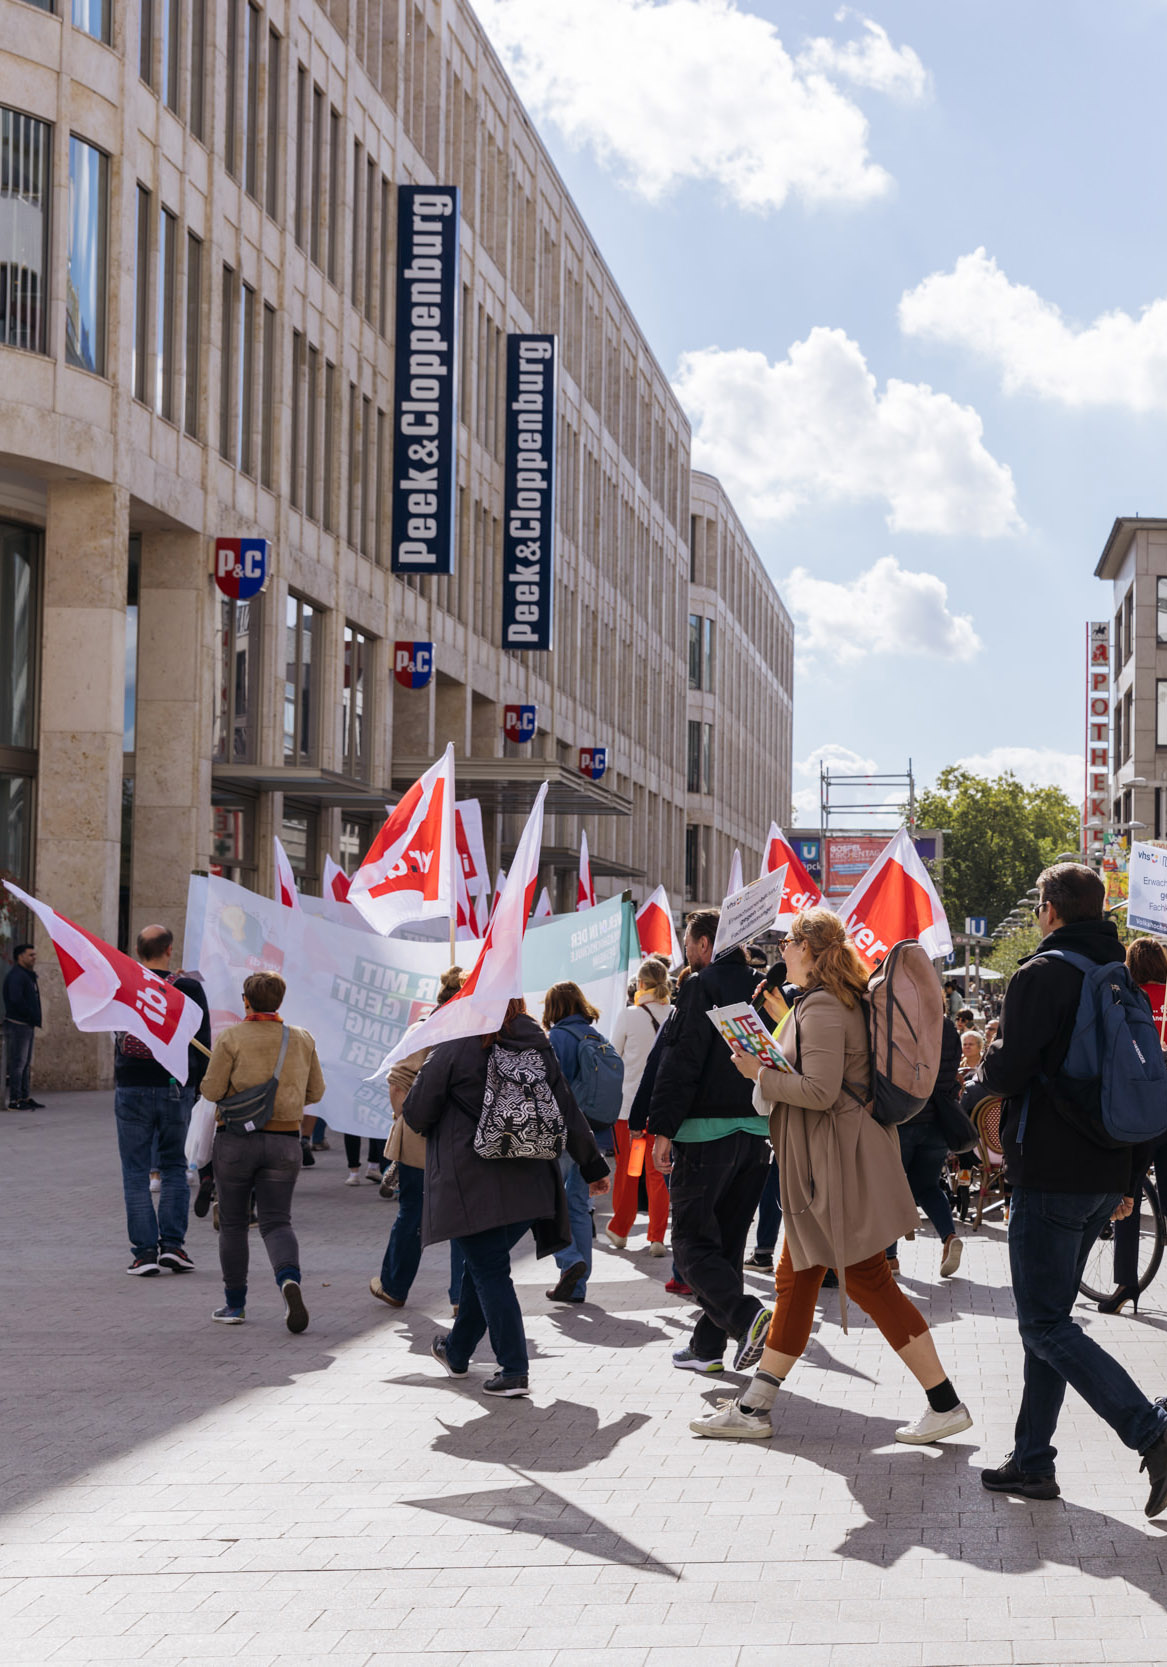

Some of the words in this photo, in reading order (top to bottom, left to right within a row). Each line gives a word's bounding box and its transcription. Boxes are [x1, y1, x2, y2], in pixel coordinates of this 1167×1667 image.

[217, 549, 262, 579] P&C
[396, 650, 431, 673] P&C
[506, 711, 534, 732] P&C
[580, 753, 605, 771] P&C
[1138, 851, 1151, 862] vhs
[971, 919, 985, 937] U
